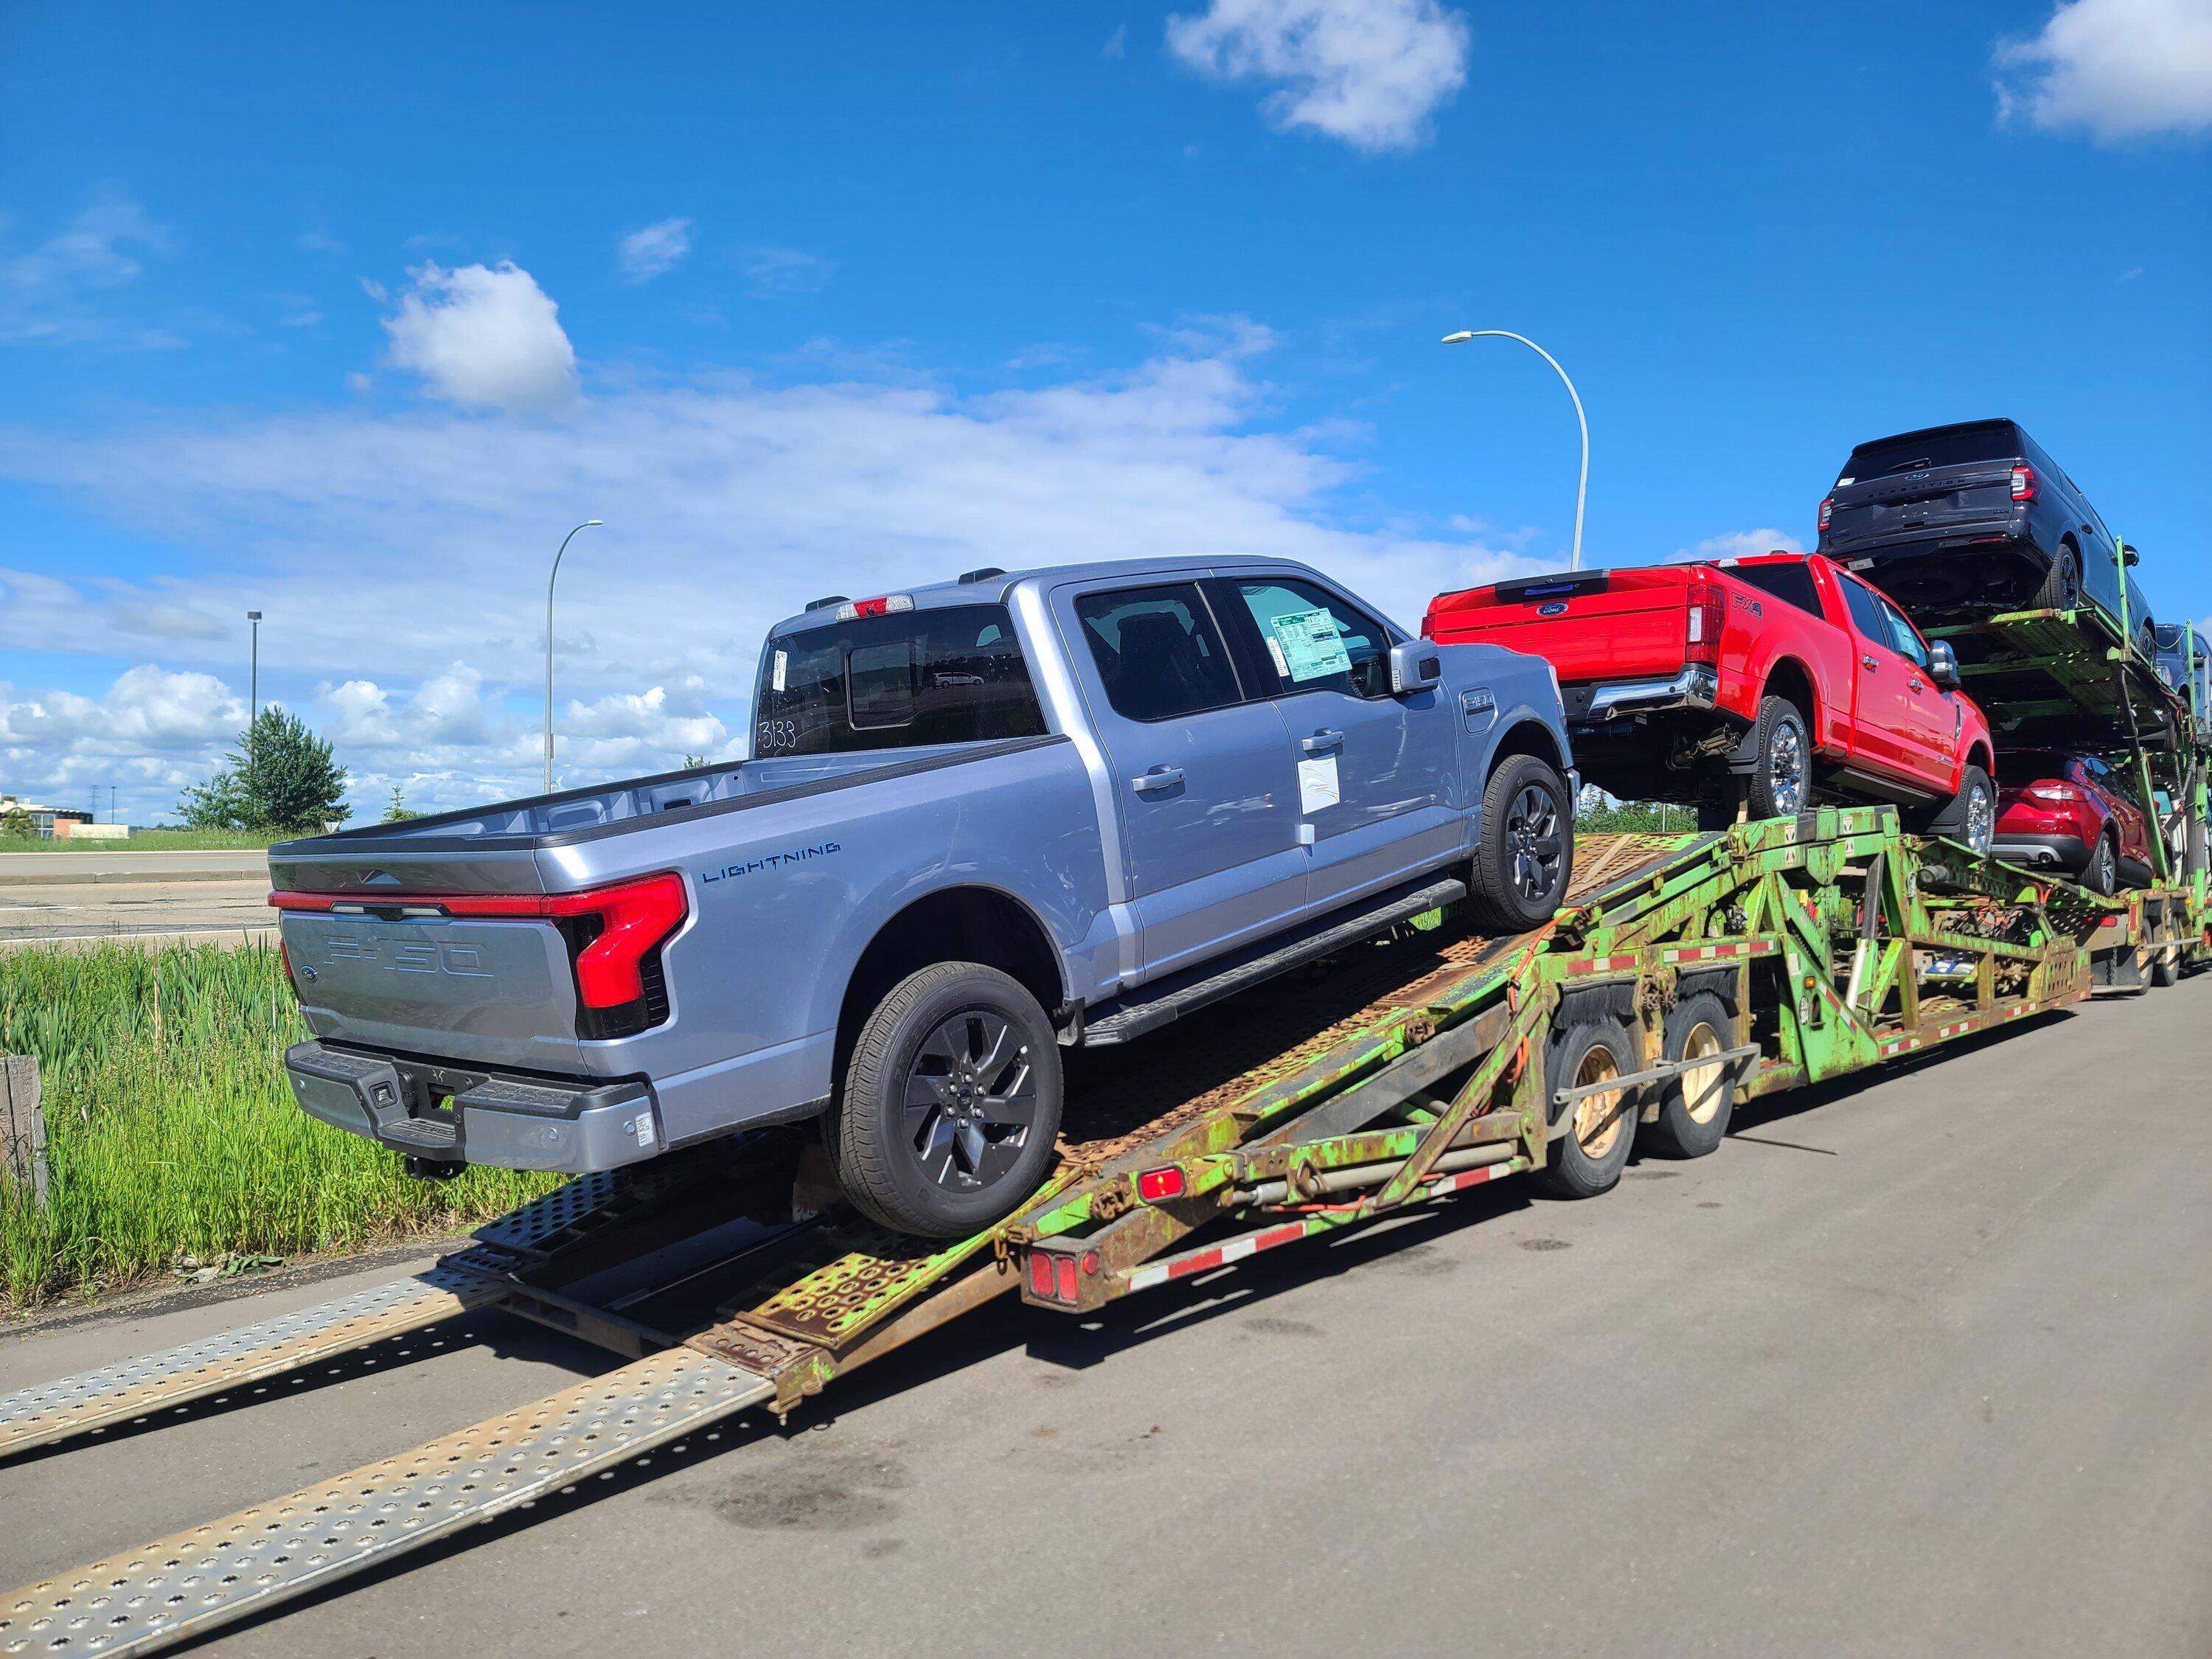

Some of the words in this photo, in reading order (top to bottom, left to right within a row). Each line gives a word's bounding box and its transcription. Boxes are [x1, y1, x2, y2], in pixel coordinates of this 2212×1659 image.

[1868, 479, 1965, 498] EXPEDITION
[1731, 591, 1763, 618] FX4
[759, 720, 796, 748] 3133
[701, 841, 842, 883] LIGHTNING
